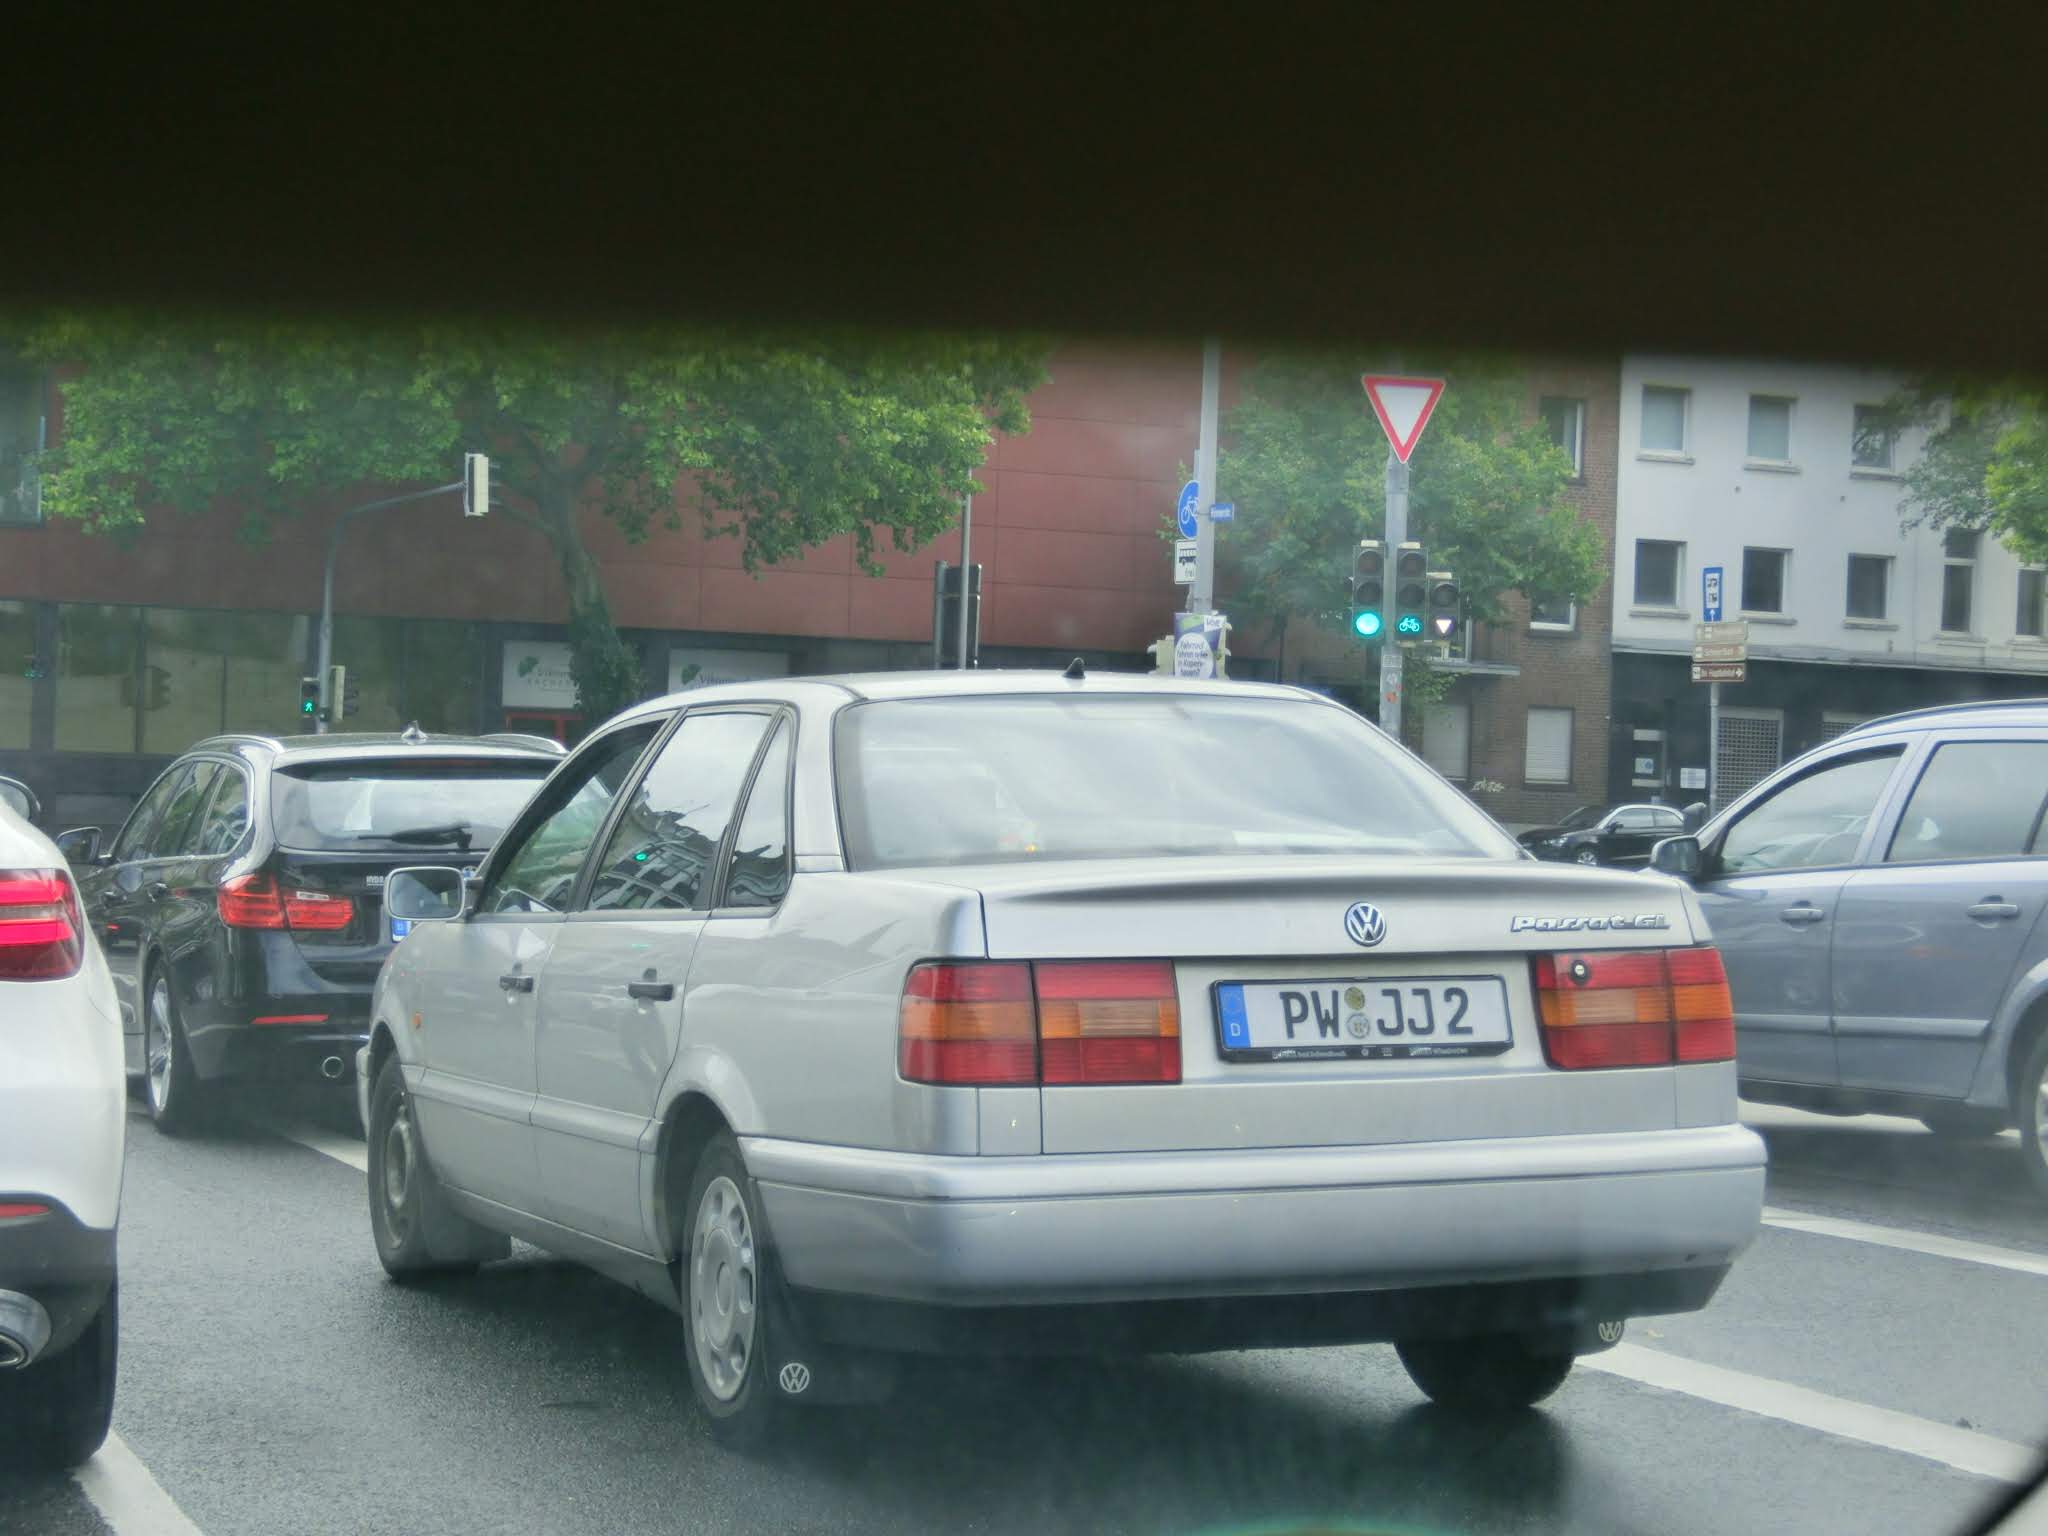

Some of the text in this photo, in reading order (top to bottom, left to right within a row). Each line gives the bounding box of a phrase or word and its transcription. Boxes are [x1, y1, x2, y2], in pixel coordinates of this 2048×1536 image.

[1510, 913, 1624, 932] Passat
[1279, 989, 1340, 1039] PW
[1230, 1023, 1240, 1037] D
[780, 1363, 810, 1393] VW
